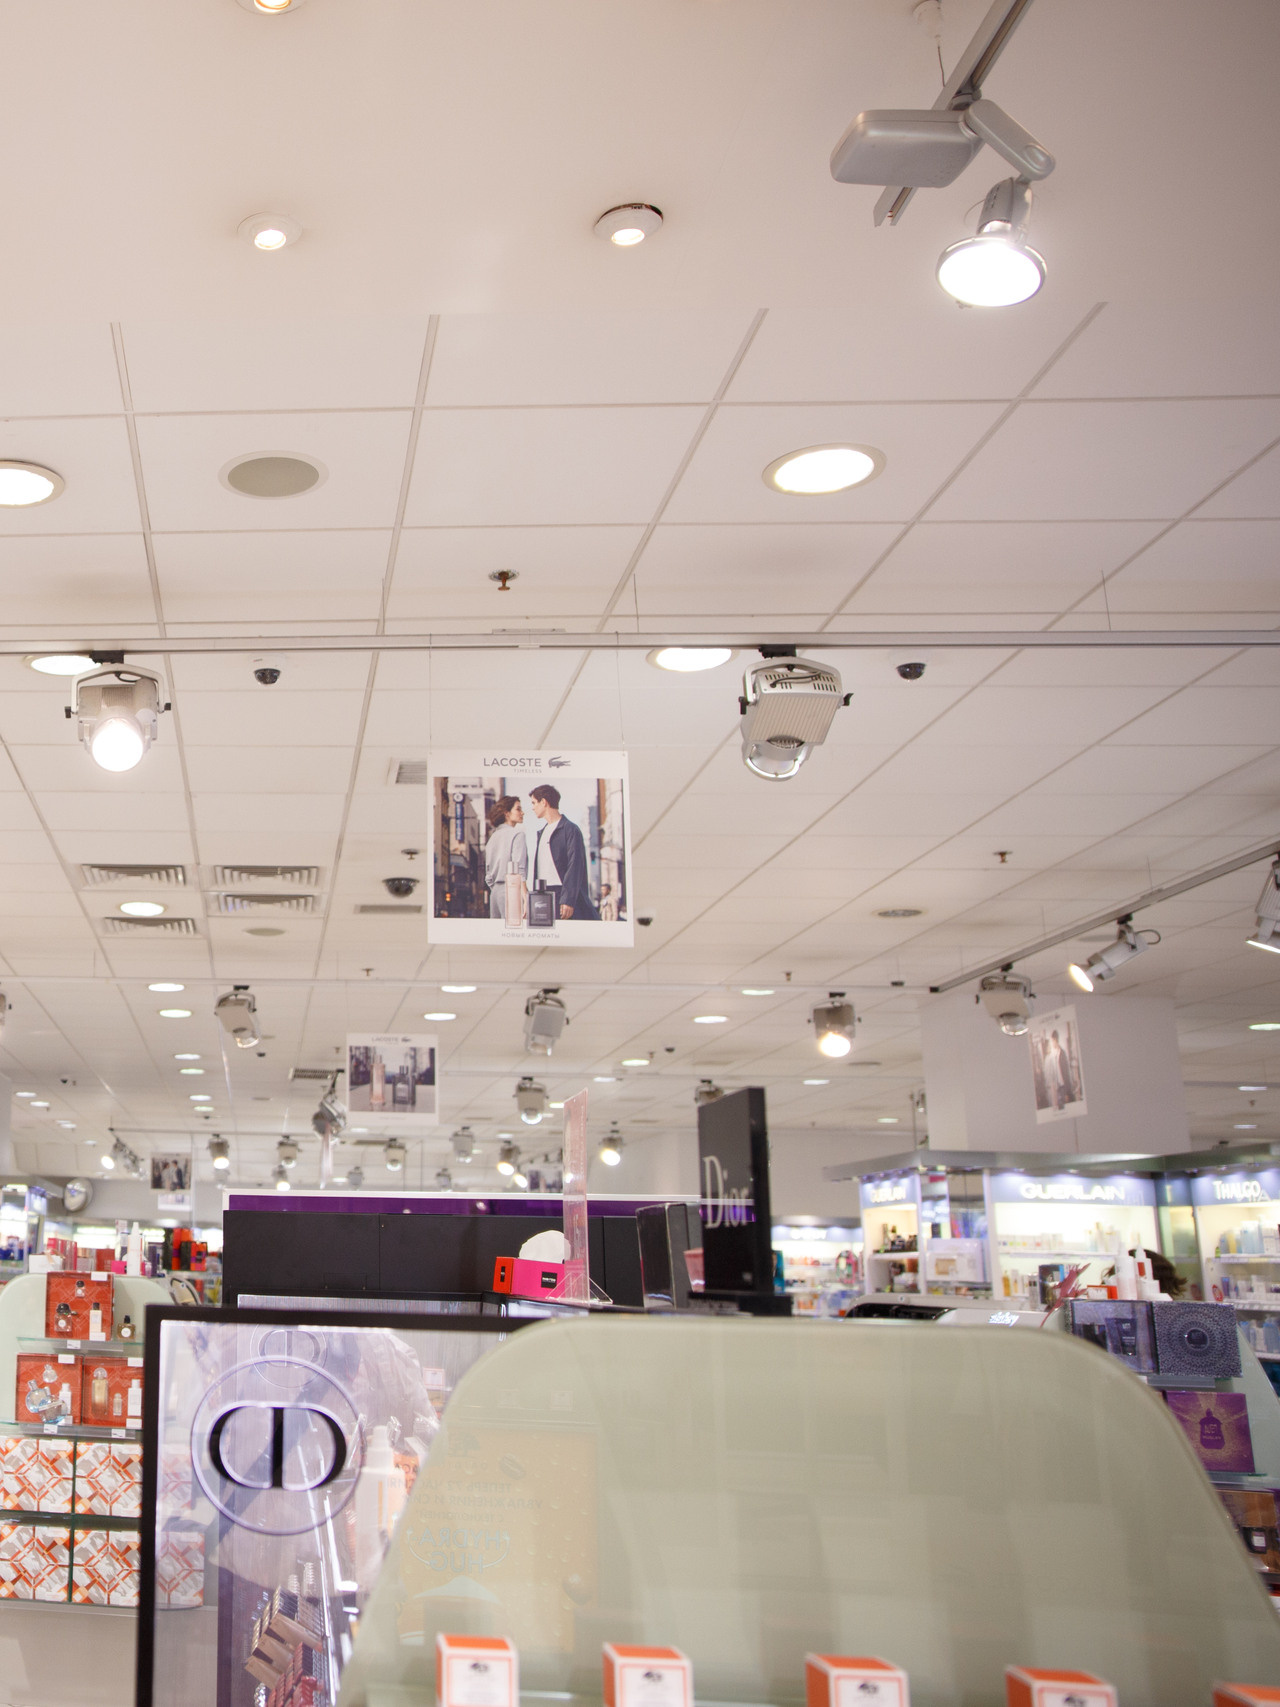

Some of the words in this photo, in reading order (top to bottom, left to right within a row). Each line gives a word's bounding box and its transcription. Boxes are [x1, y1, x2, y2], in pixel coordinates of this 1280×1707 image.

[483, 757, 542, 767] LACOSTE
[527, 932, 560, 940] АРОМАТЫ
[703, 1155, 749, 1230] Dior
[1019, 1183, 1125, 1201] GUERLAIN
